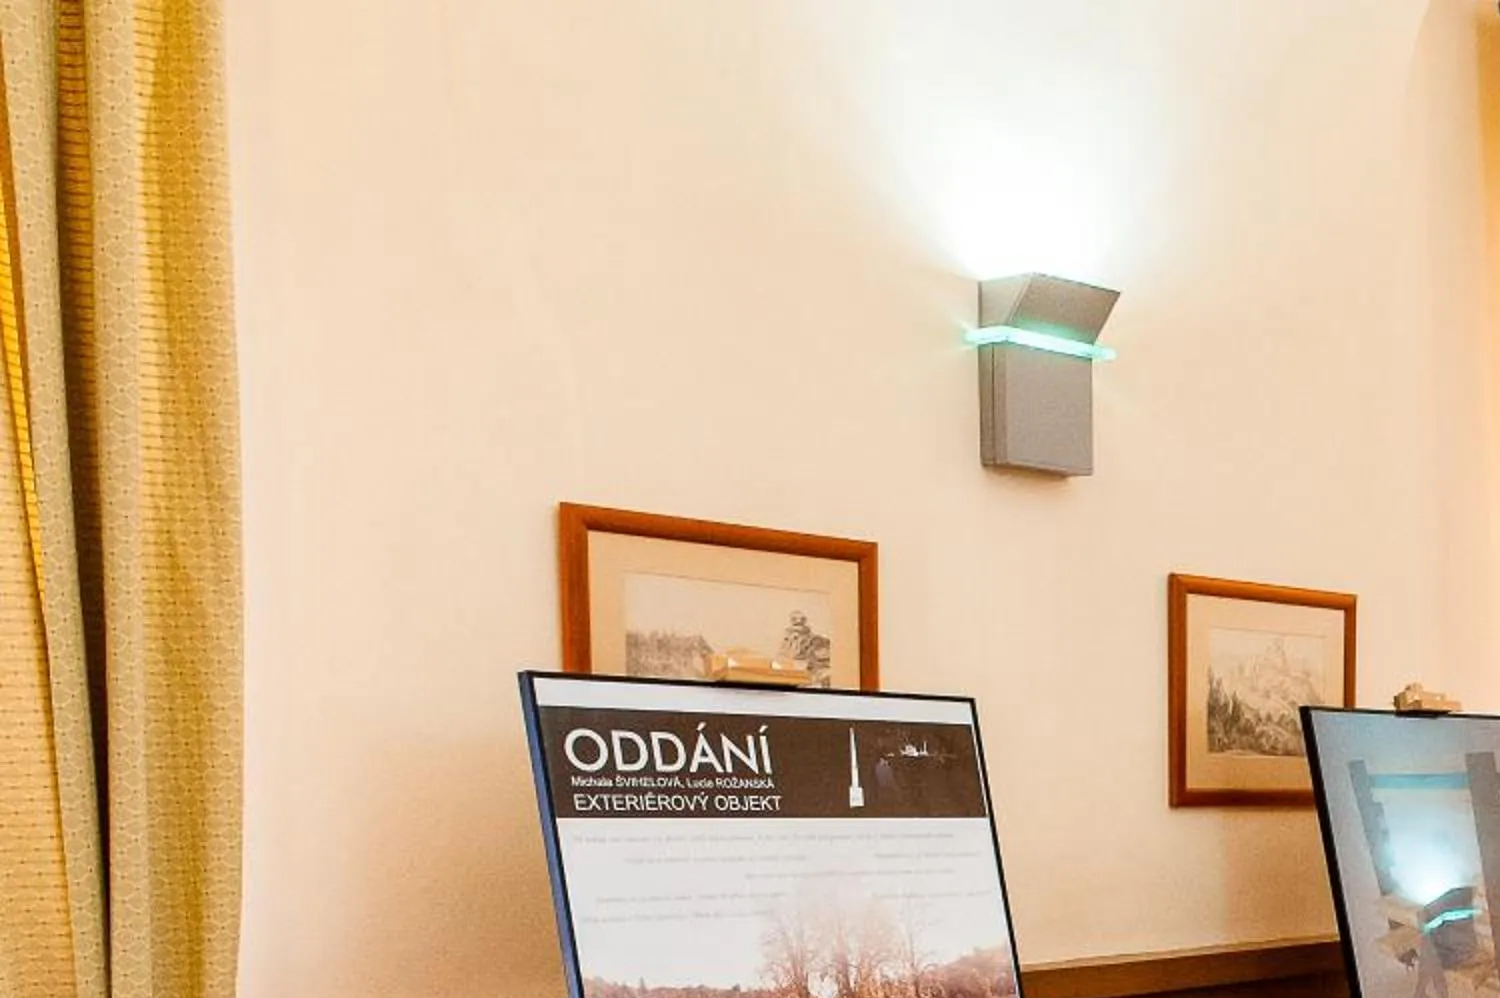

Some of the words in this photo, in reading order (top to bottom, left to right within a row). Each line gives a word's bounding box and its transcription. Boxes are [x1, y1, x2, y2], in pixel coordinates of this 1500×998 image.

[564, 722, 772, 774] ODDÁNÍ
[573, 791, 709, 811] EXTERIÉROVÝ
[714, 795, 782, 811] OBJEKT
